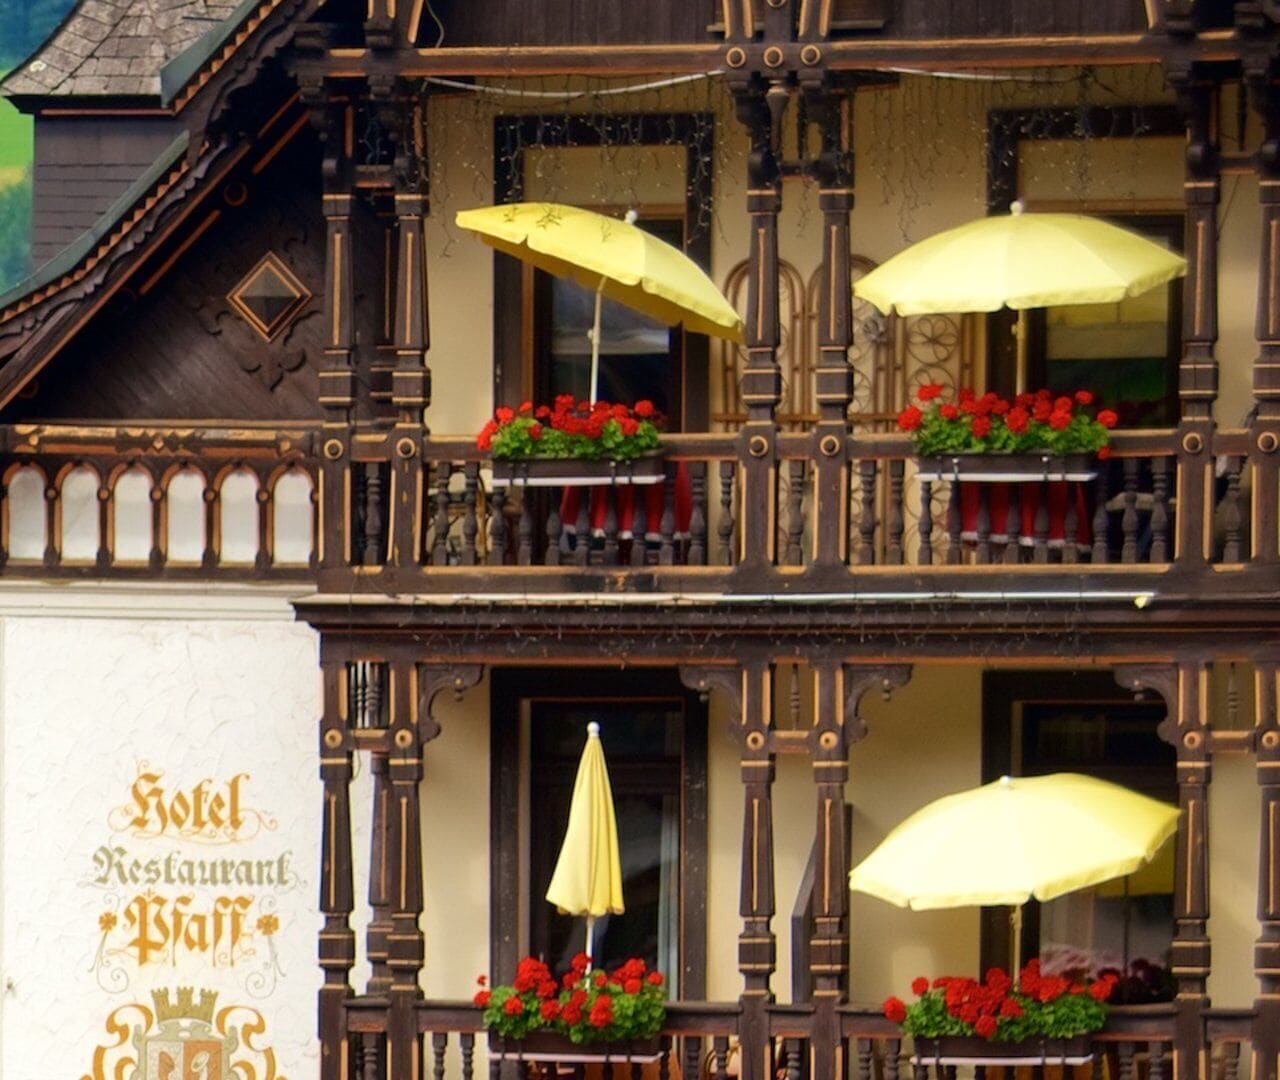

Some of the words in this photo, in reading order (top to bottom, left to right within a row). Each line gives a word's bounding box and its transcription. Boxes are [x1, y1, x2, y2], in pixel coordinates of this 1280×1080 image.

[124, 766, 252, 836] Hotel
[92, 845, 293, 887] Restaurant
[124, 888, 253, 968] Pfaff
